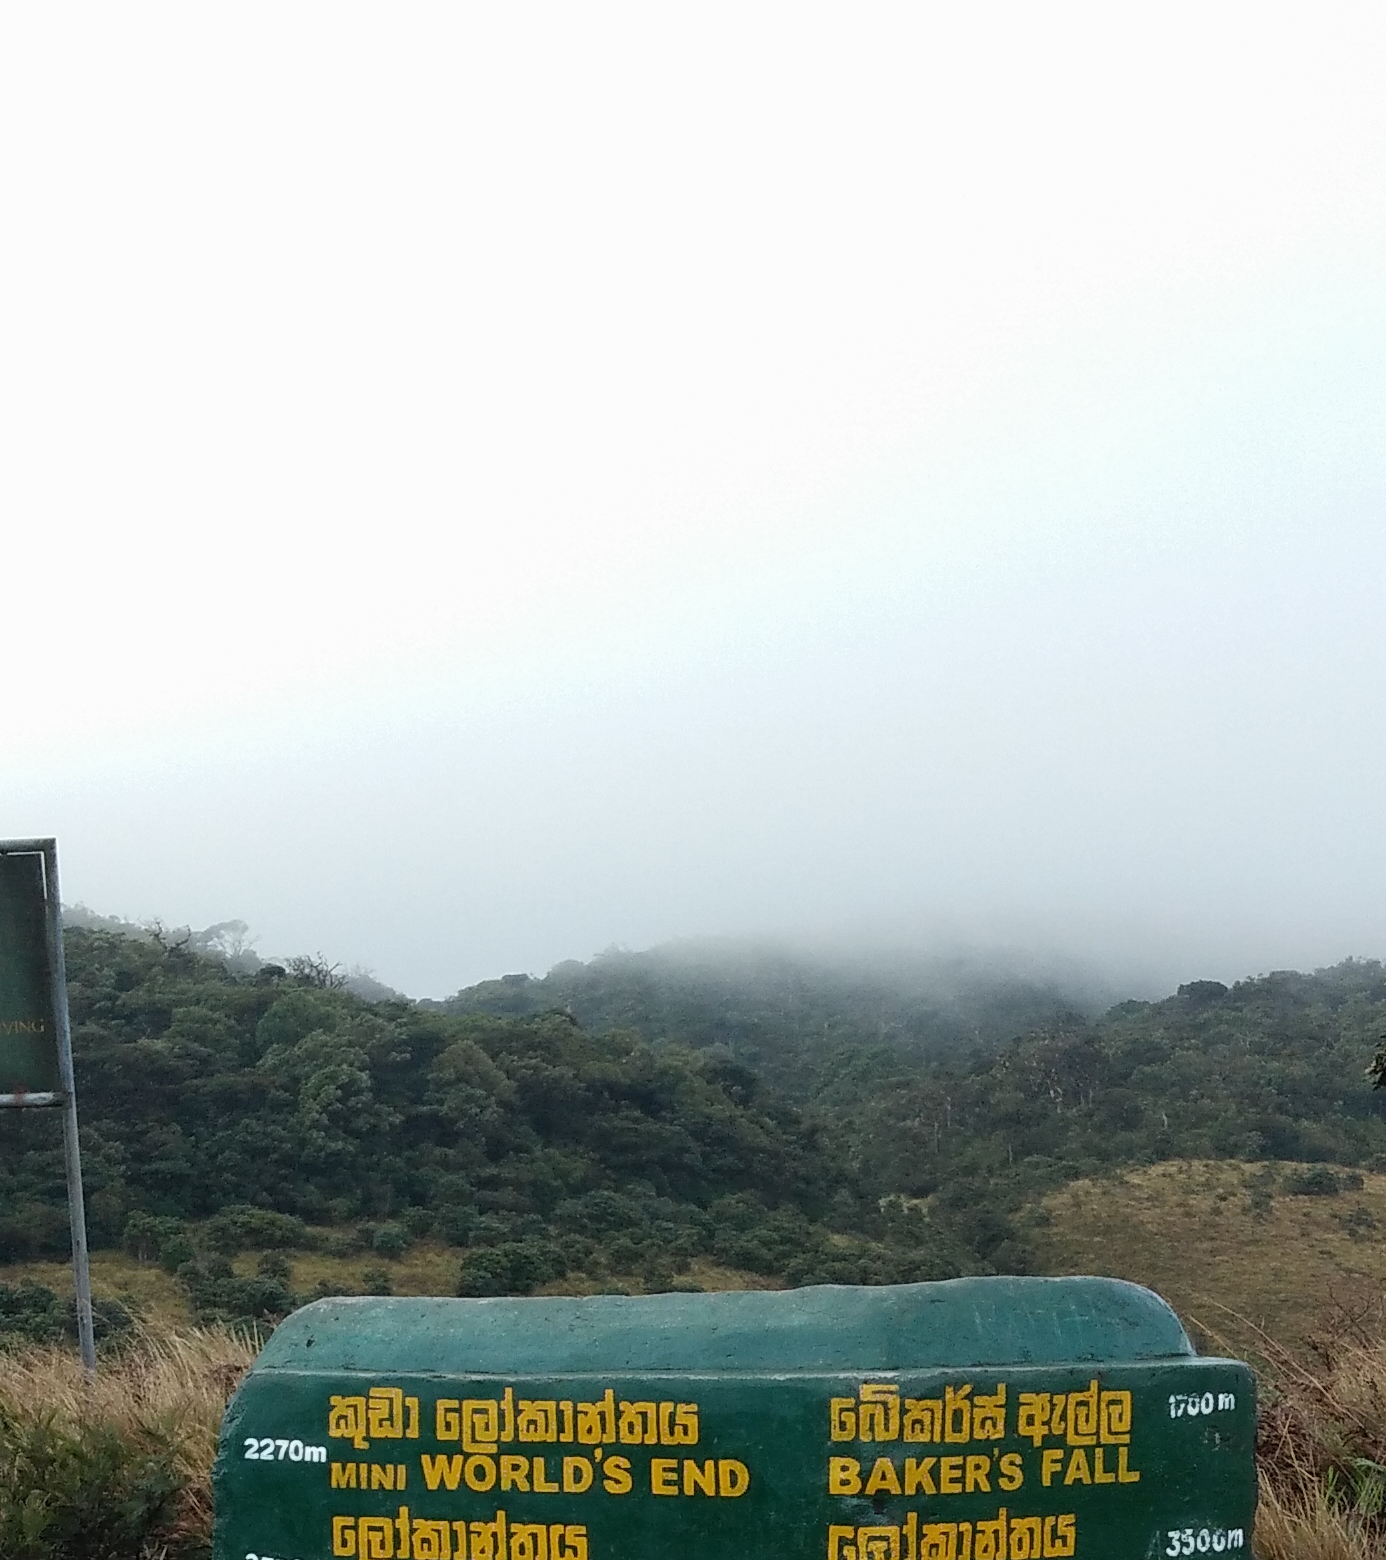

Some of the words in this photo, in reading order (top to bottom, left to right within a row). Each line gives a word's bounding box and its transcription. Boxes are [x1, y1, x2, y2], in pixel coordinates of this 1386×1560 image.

[244, 1438, 326, 1462] 2270m
[331, 1463, 406, 1490] MINI
[421, 1446, 632, 1494] WORLD'S
[651, 1459, 749, 1496] END
[829, 1449, 1023, 1495] BAKER'S
[1042, 1447, 1139, 1486] FALL
[1166, 1529, 1243, 1556] 3500m
